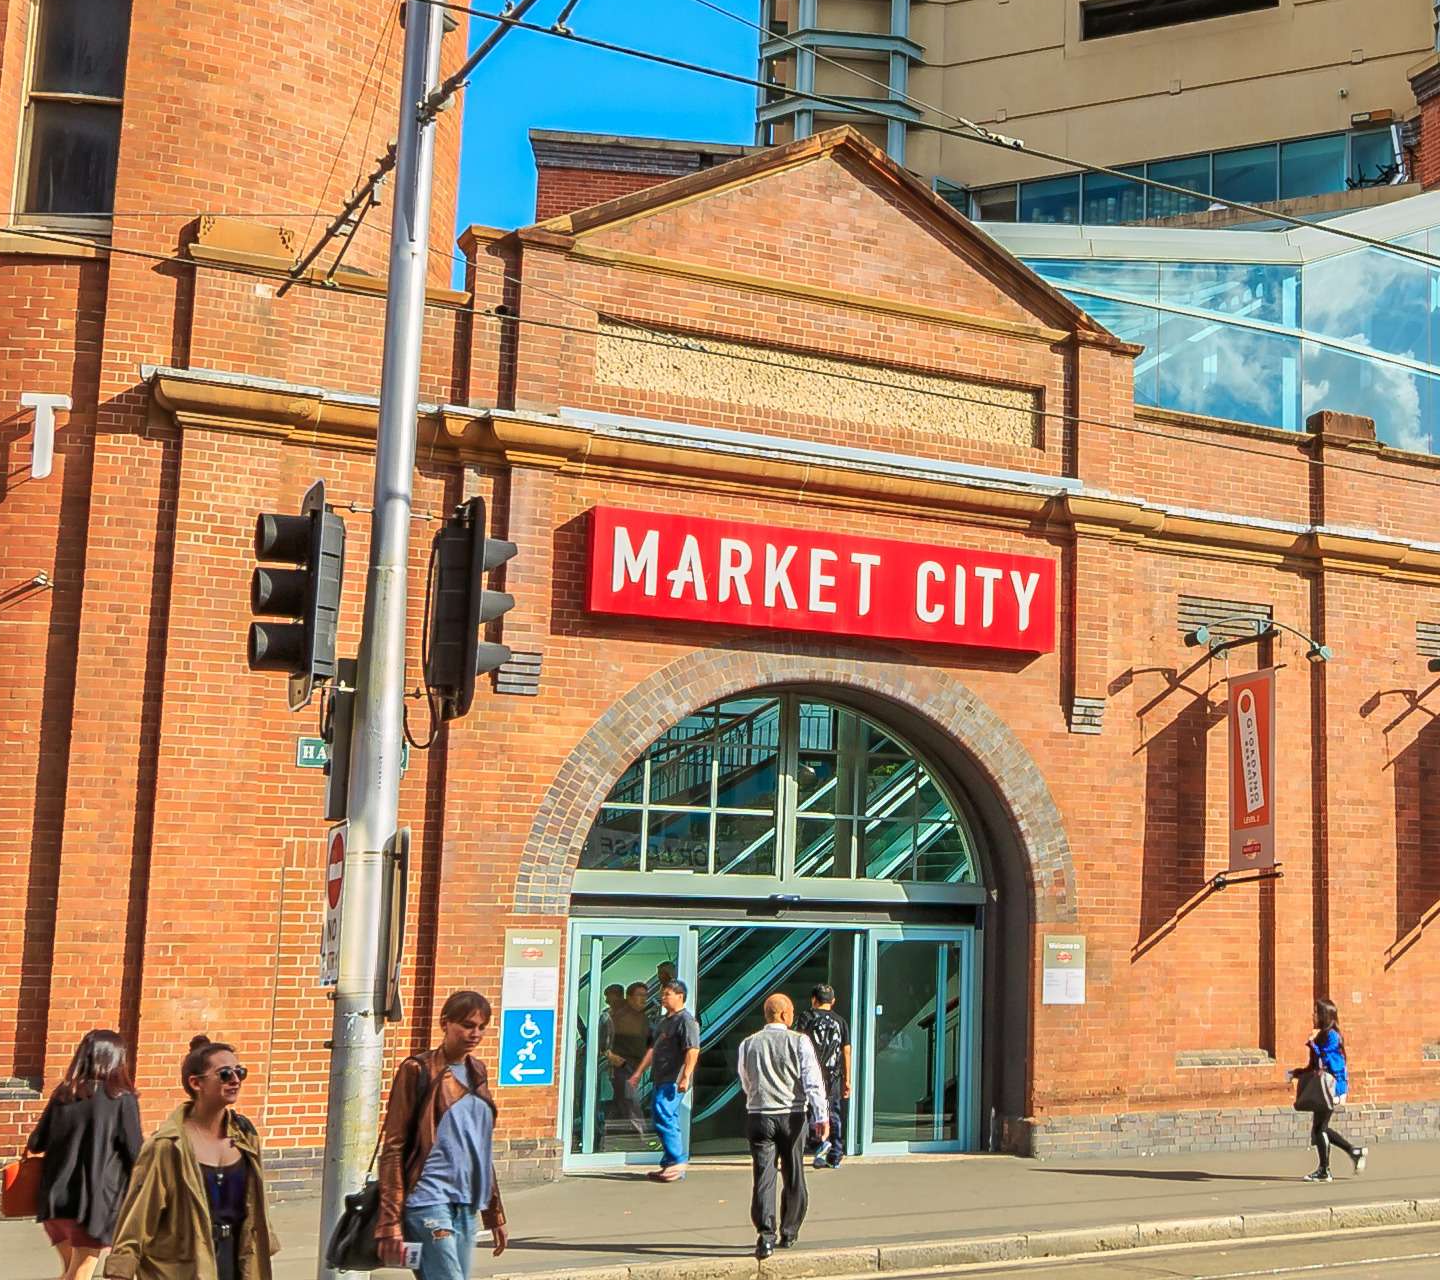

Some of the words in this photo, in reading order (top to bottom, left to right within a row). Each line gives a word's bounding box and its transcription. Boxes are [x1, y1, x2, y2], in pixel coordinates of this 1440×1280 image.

[611, 526, 881, 617] MARKET
[916, 560, 1040, 632] CITY
[1246, 717, 1260, 803] GIORDANO
